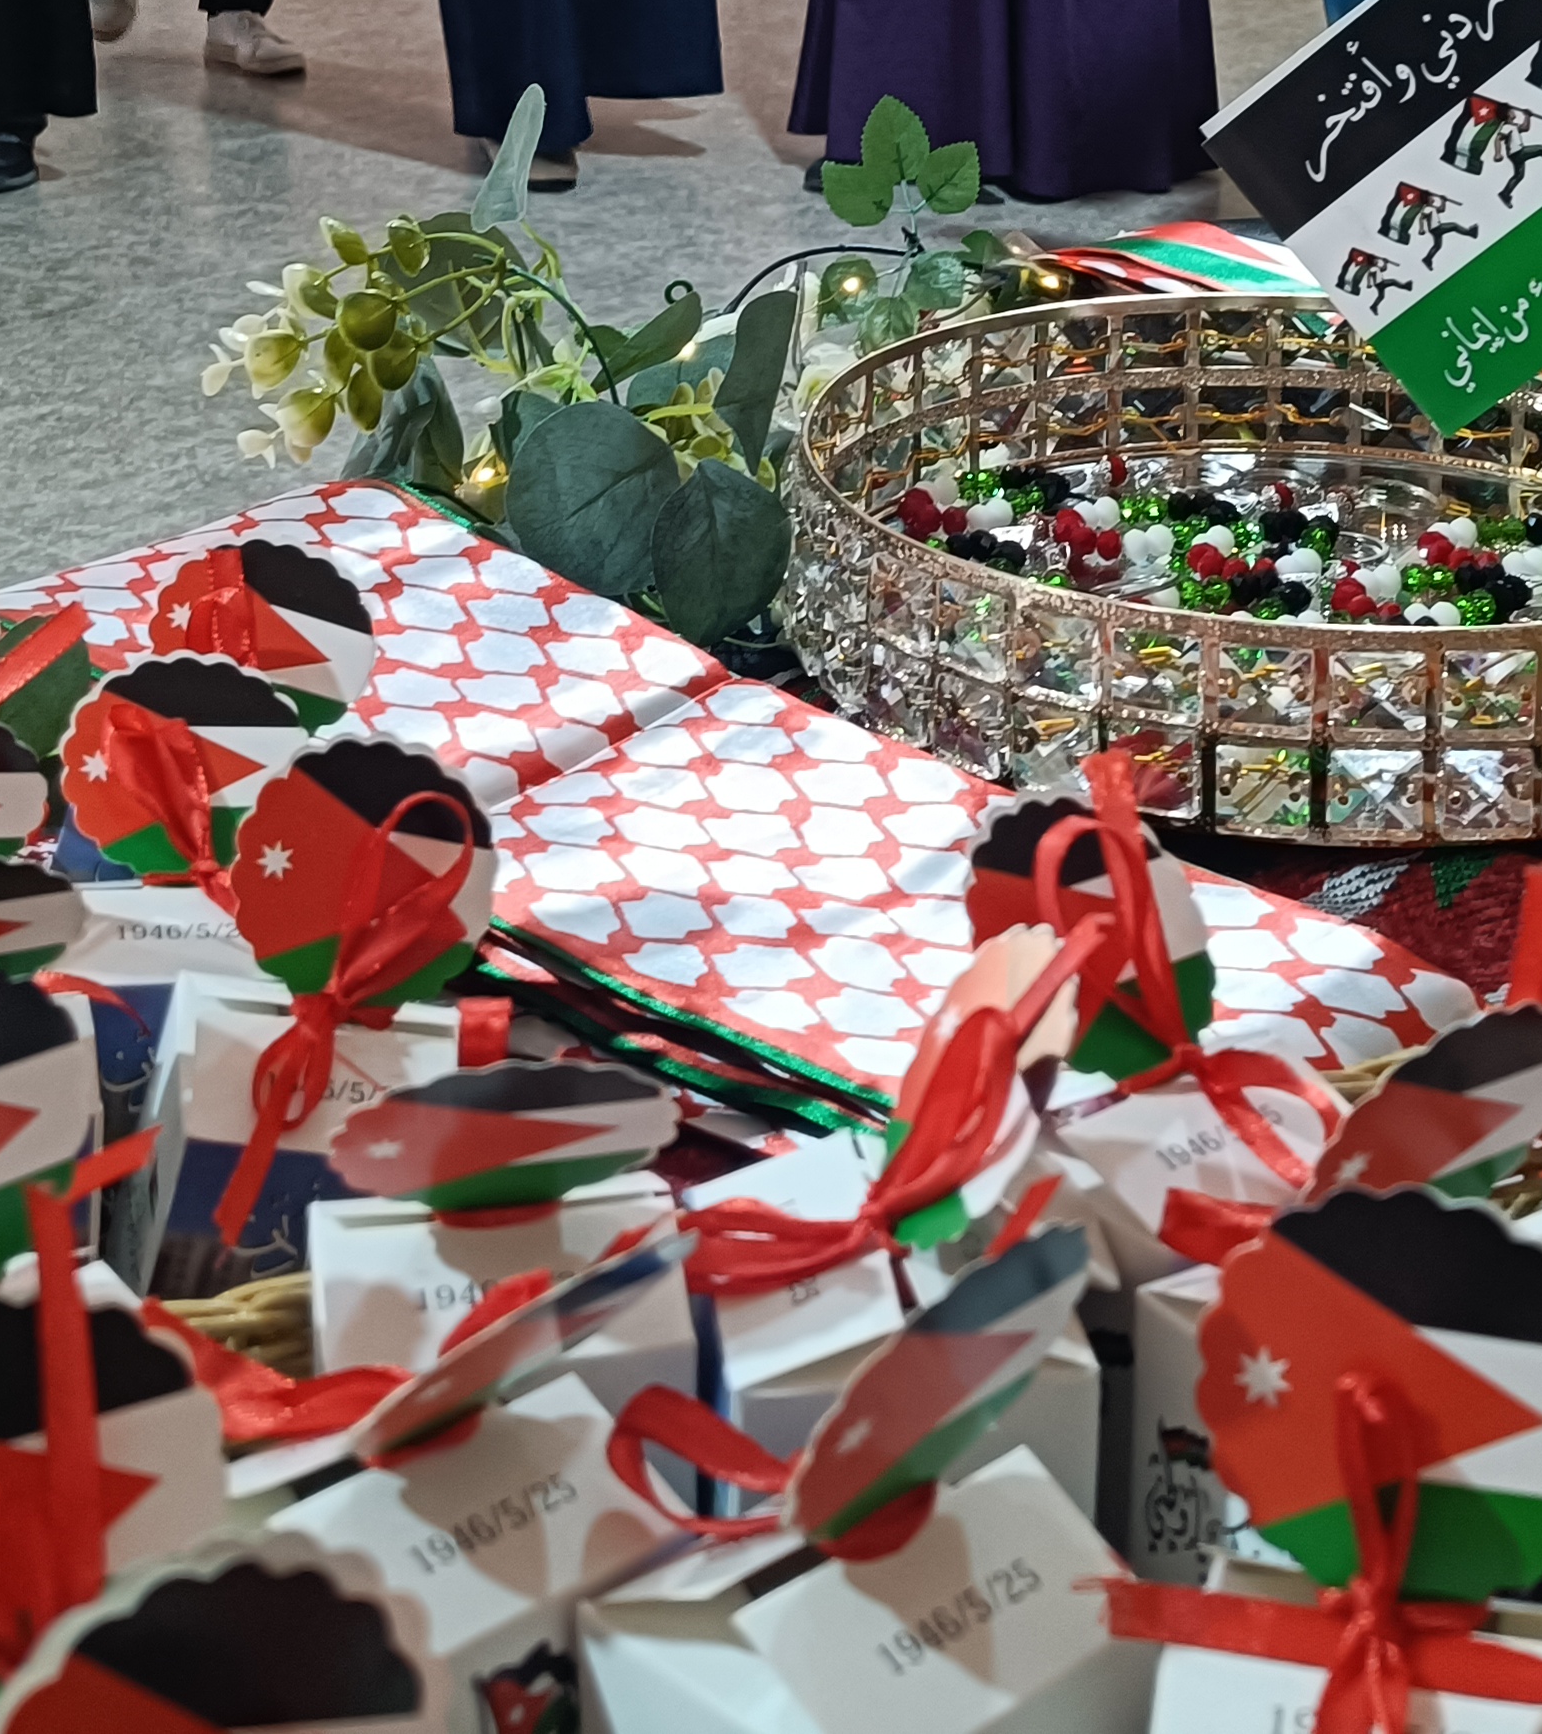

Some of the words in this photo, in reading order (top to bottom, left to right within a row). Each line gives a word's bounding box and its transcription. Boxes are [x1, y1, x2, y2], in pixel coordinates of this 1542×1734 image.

[1305, 39, 1415, 183] وأفتخر
[1501, 296, 1530, 343] من
[115, 921, 240, 943] 1946/5/2
